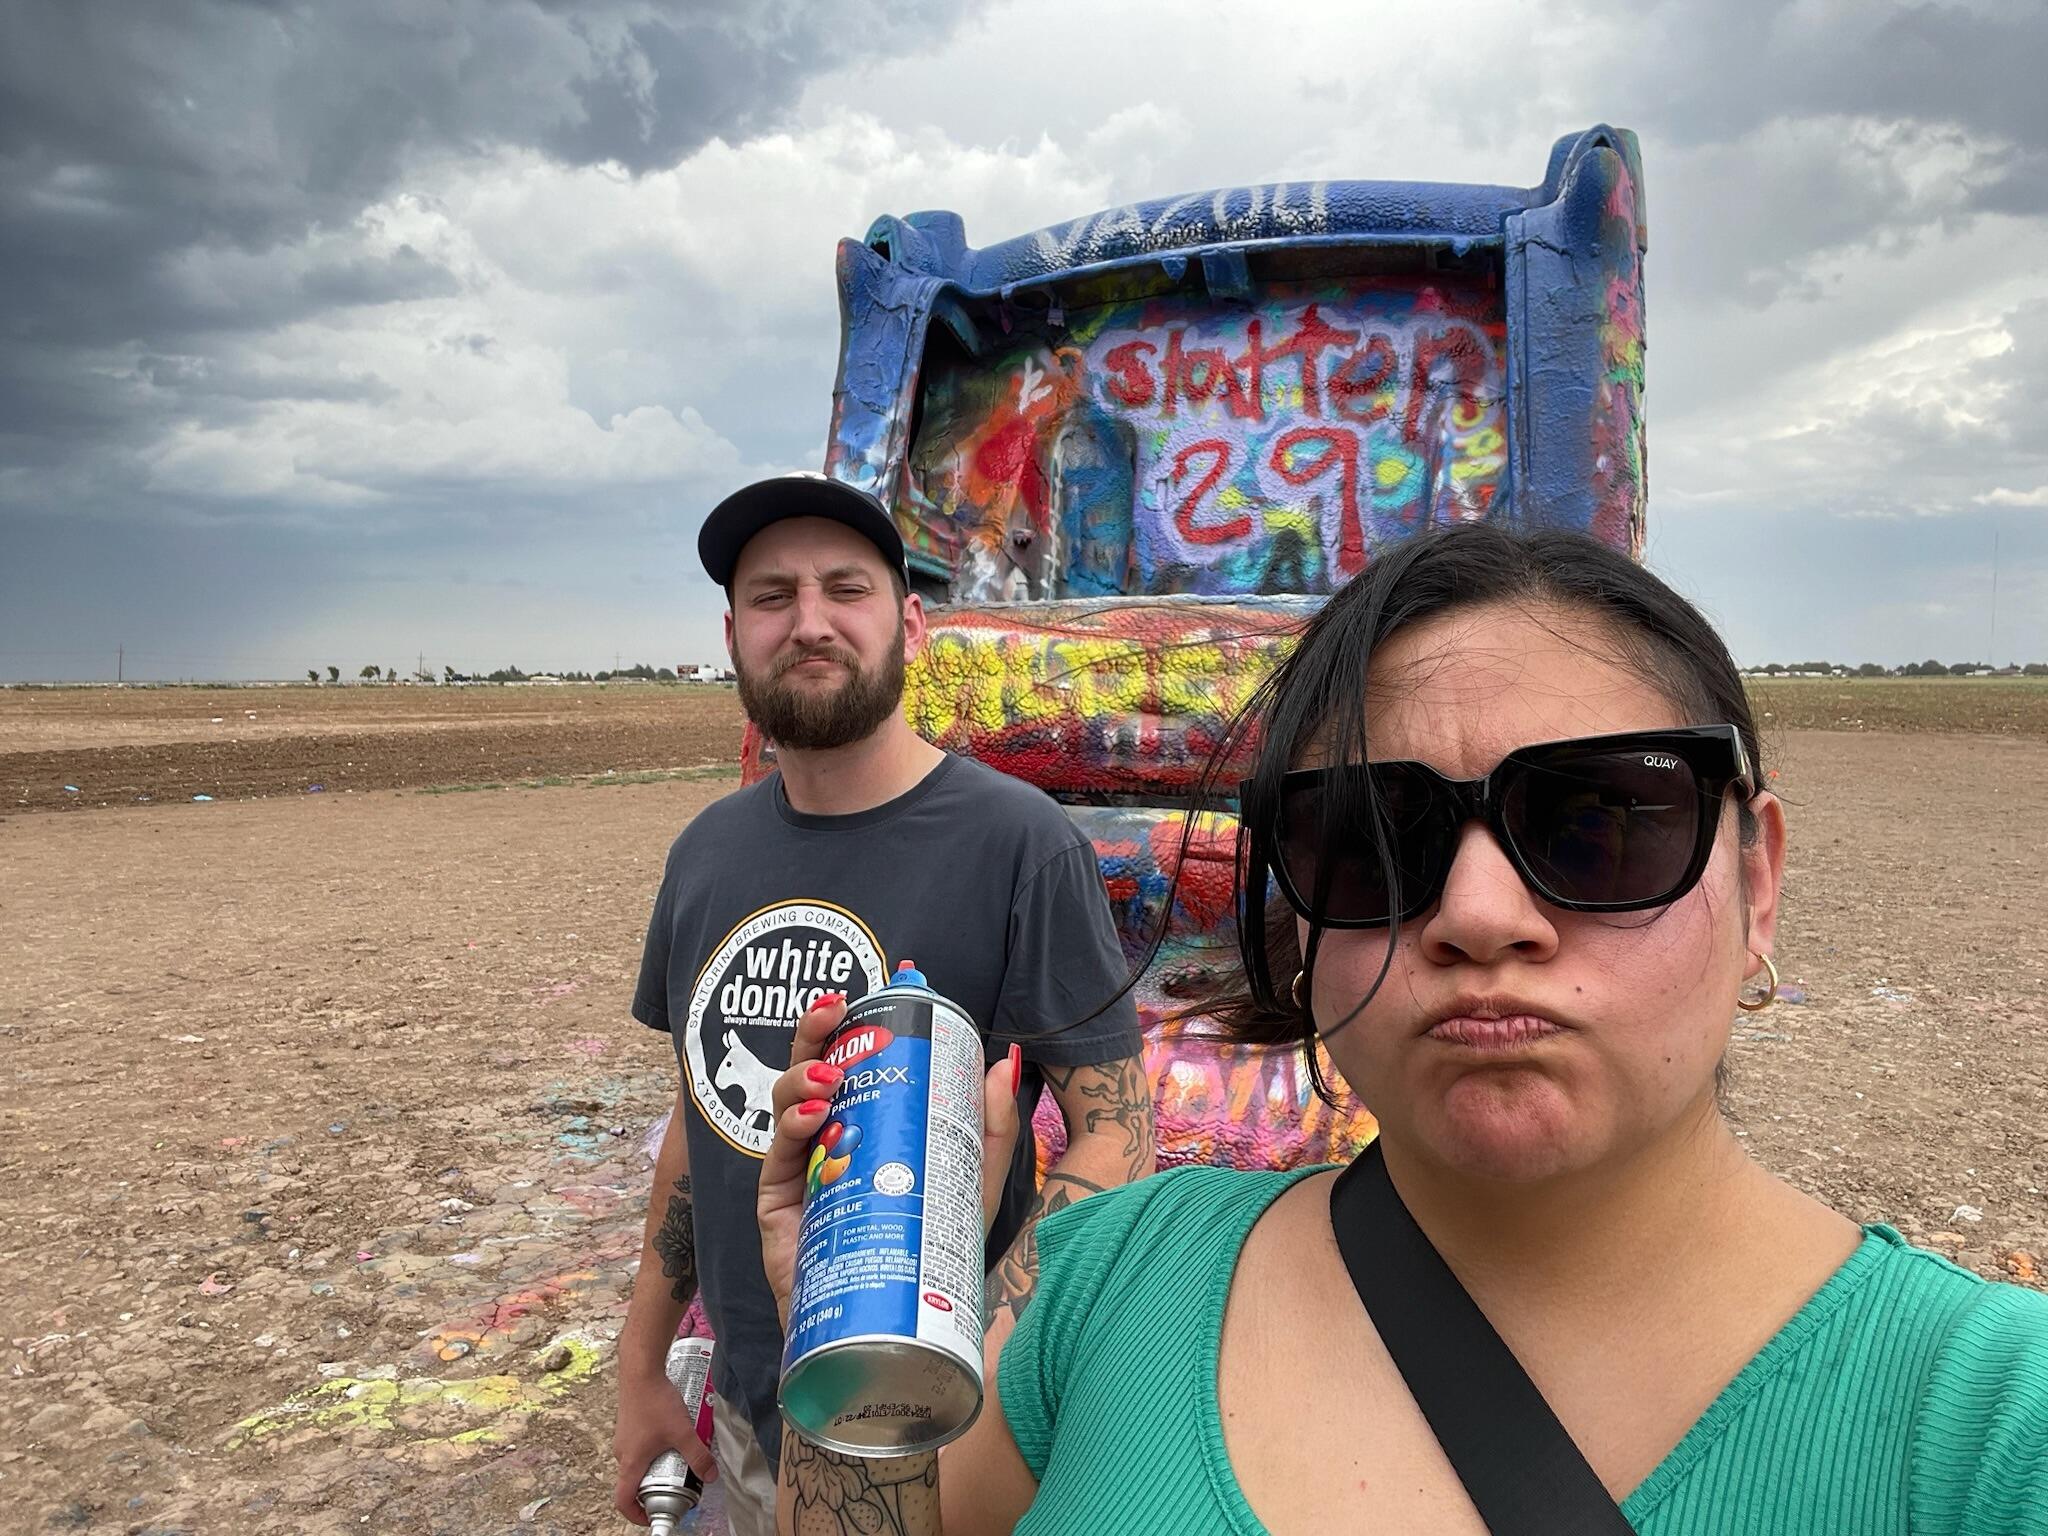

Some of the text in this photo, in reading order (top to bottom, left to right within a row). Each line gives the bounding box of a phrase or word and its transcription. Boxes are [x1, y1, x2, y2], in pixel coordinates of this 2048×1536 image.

[1173, 426, 1366, 575] 29
[1643, 755, 1678, 769] QUAY
[690, 949, 733, 1028] SANTORINI
[735, 911, 798, 946] BREWING
[804, 911, 866, 949] COMPANY
[746, 938, 854, 983] white
[720, 974, 848, 1020] donke
[724, 1015, 747, 1026] always
[748, 1016, 782, 1027] unfiltered
[783, 1019, 795, 1027] and
[852, 1013, 863, 1021] NO
[826, 1031, 875, 1066] YLON
[831, 1089, 881, 1116] PRIMER
[819, 1178, 862, 1202] OUTDOOR
[809, 1211, 833, 1234] TRUE
[833, 1201, 863, 1219] BLUE
[844, 1223, 905, 1237] FOR METAL, WOOD,
[842, 1233, 905, 1246] PLASTIC AND MORE
[807, 1313, 817, 1329] OZ
[816, 1306, 834, 1326] (340
[834, 1303, 843, 1320] g)
